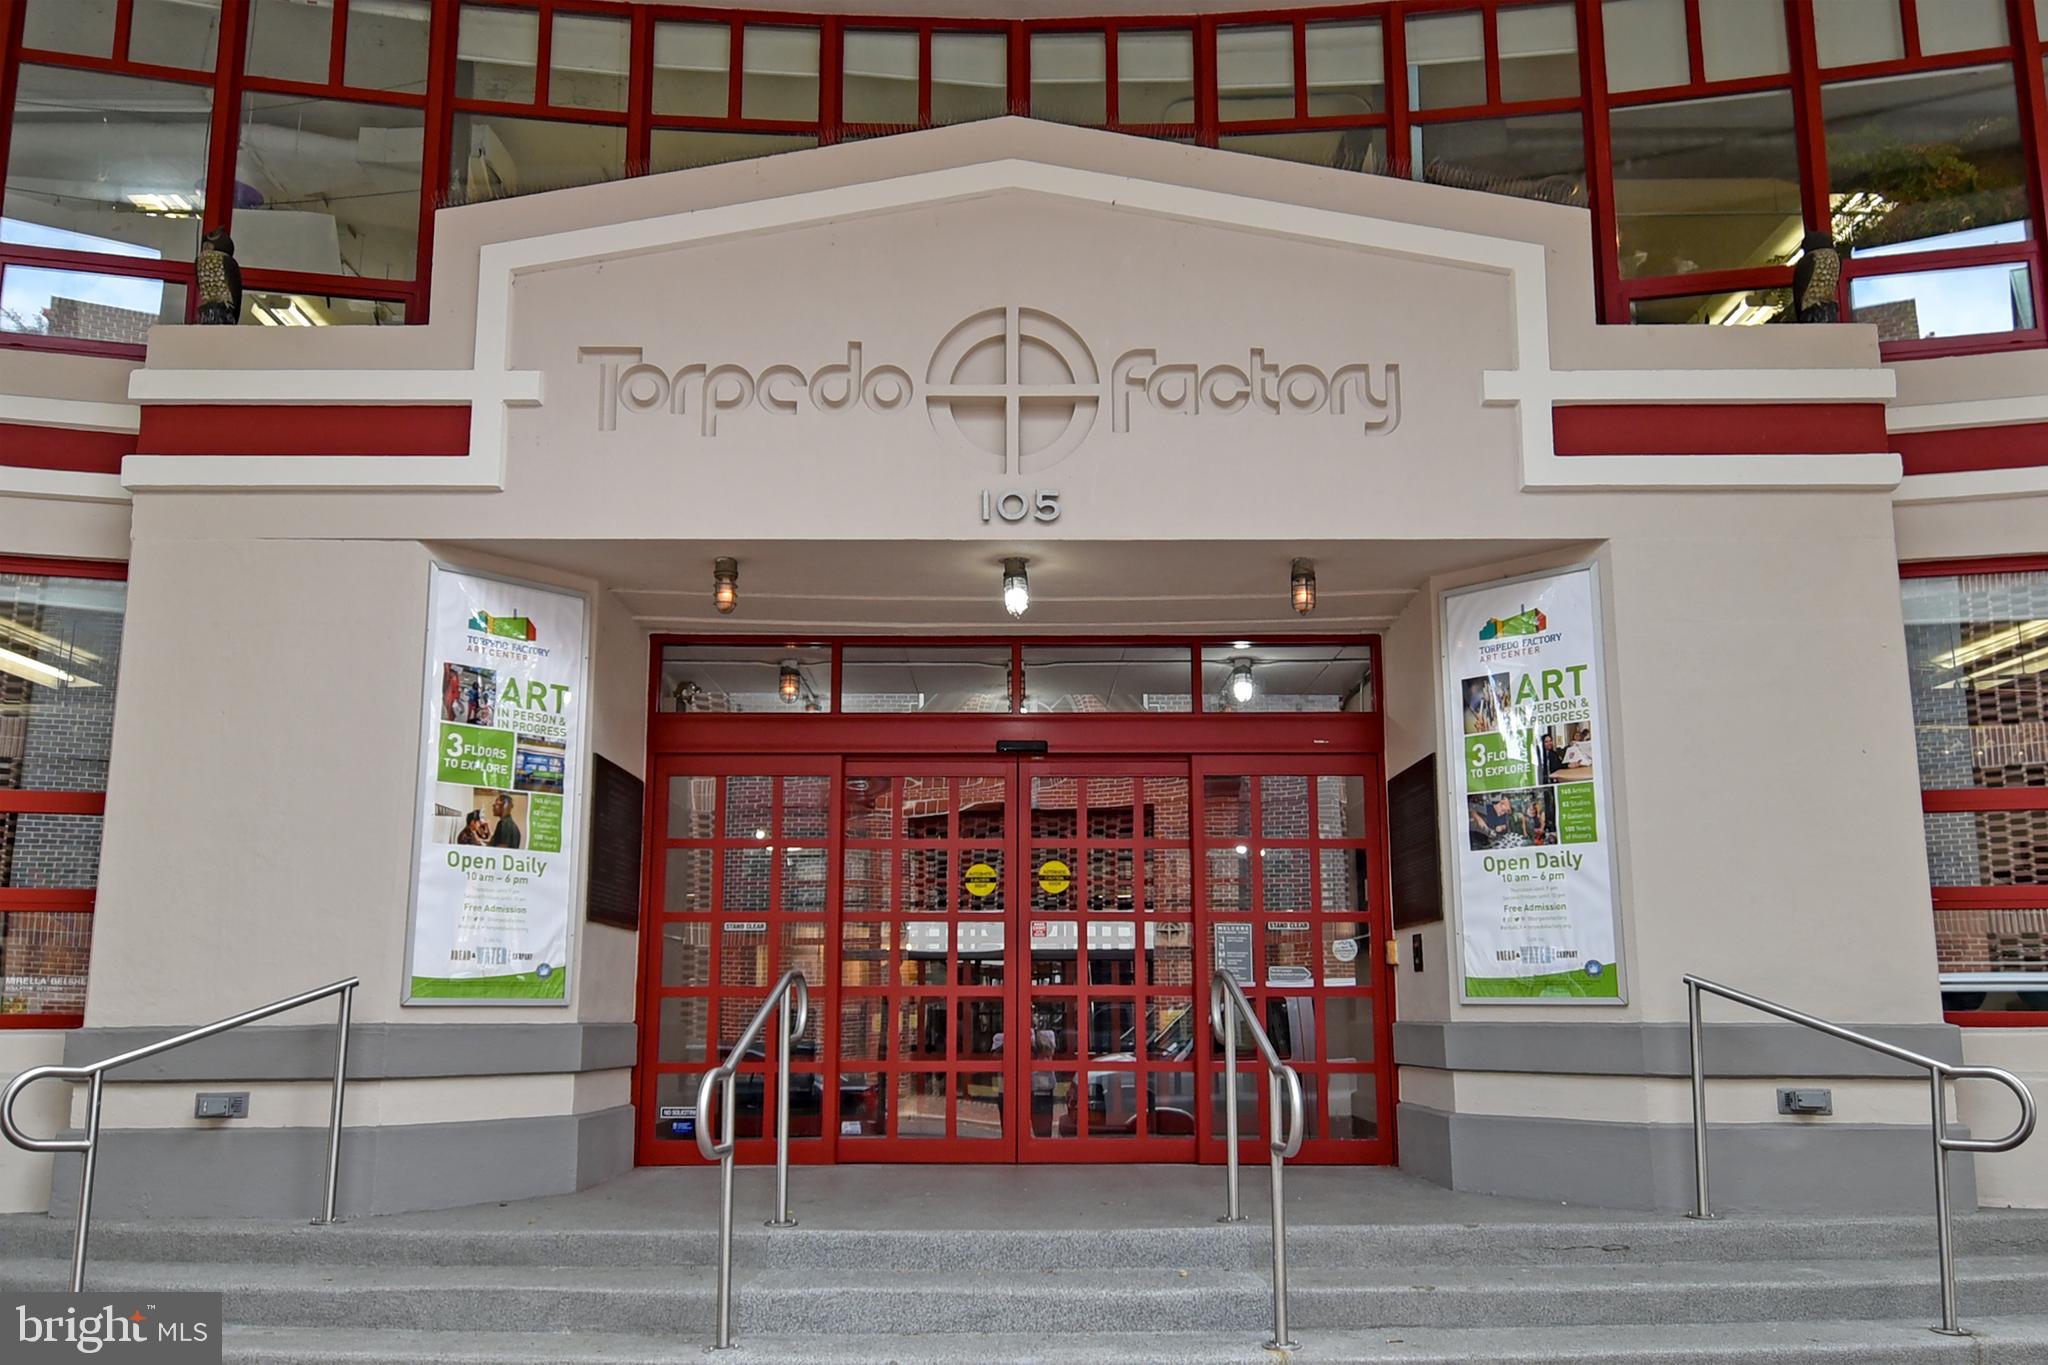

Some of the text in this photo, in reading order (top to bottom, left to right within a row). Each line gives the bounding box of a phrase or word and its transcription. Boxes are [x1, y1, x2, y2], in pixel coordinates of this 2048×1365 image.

[981, 489, 1061, 522] 105
[467, 645, 528, 660] ART CENTER
[511, 643, 550, 657] FACTORY
[1479, 633, 1563, 655] TORPEDO FACTORY
[1479, 646, 1541, 663] ART CENTER
[1515, 664, 1588, 705] ART
[500, 677, 570, 714] ART
[1514, 706, 1527, 717] IN
[1580, 698, 1589, 708] &
[497, 708, 566, 726] IN PERSON &
[1530, 709, 1590, 726] PROGRESS
[497, 719, 567, 737] IN PROGRESS
[446, 733, 508, 760] 3 FLOORS
[1471, 743, 1487, 767] 3
[444, 757, 509, 775] TO EXPLORE
[1470, 763, 1532, 778] TO EXPLORE
[447, 851, 548, 877] Open Daily
[1483, 851, 1583, 875] Open Daily
[466, 872, 477, 881] 10
[478, 874, 494, 883] am
[504, 874, 511, 884] 6
[513, 876, 529, 887] pm
[1501, 874, 1512, 883] 10
[1514, 874, 1529, 882] am
[1540, 872, 1546, 880] 6
[1549, 872, 1565, 882] pm
[463, 903, 527, 914] Free Admission
[1503, 903, 1567, 913] Free Admission
[1556, 950, 1578, 959] COMPANY
